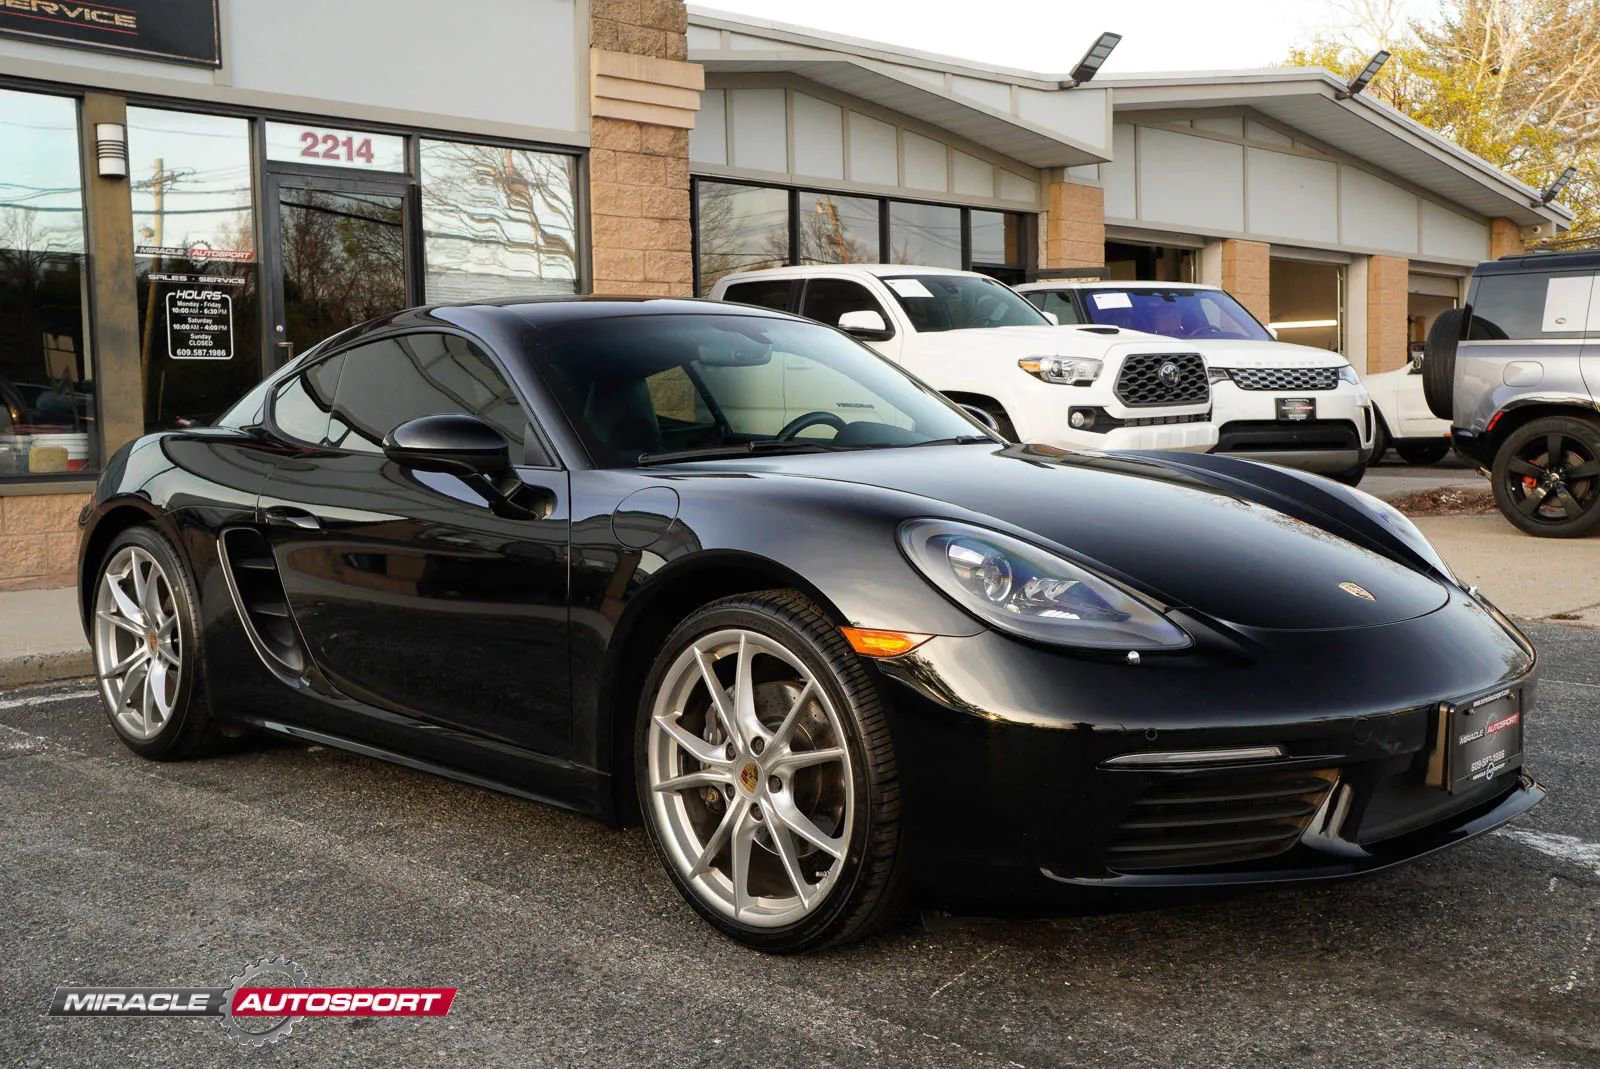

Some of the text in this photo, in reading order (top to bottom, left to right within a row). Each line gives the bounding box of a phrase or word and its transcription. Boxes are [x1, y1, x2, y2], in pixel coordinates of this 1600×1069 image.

[0, 0, 136, 28] ERVICE
[300, 131, 374, 163] 2214
[139, 247, 251, 259] MIRACLE AUTOSPORT
[148, 274, 246, 284] SALES SERVICE
[176, 290, 222, 300] HOURS
[187, 317, 213, 325] Saturday
[176, 348, 226, 357] 609.587.1986
[1459, 715, 1518, 745] MIRACLE AUTOSPORT
